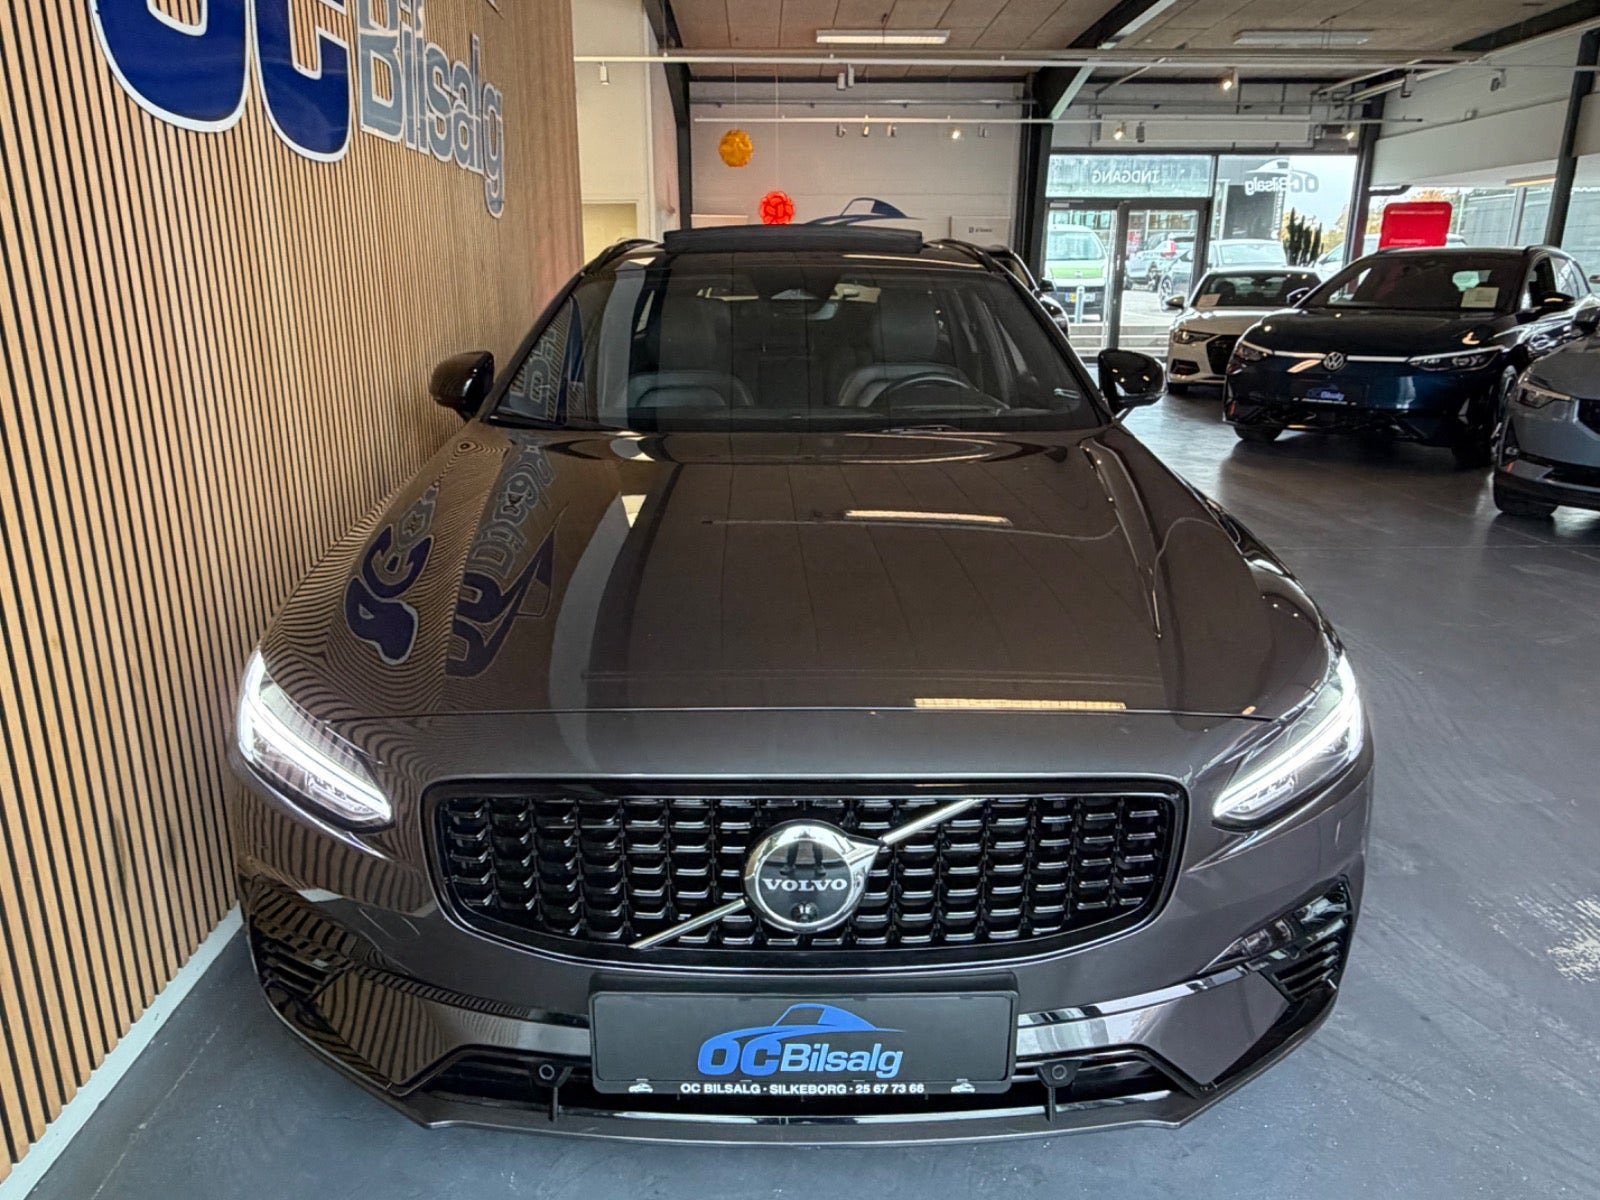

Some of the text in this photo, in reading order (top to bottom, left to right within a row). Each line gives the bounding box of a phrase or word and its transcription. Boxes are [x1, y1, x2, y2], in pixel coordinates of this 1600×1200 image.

[762, 878, 848, 892] VOLVO
[680, 1083, 925, 1094] OC BILSALG SILKEBORG 25 67 73 66
